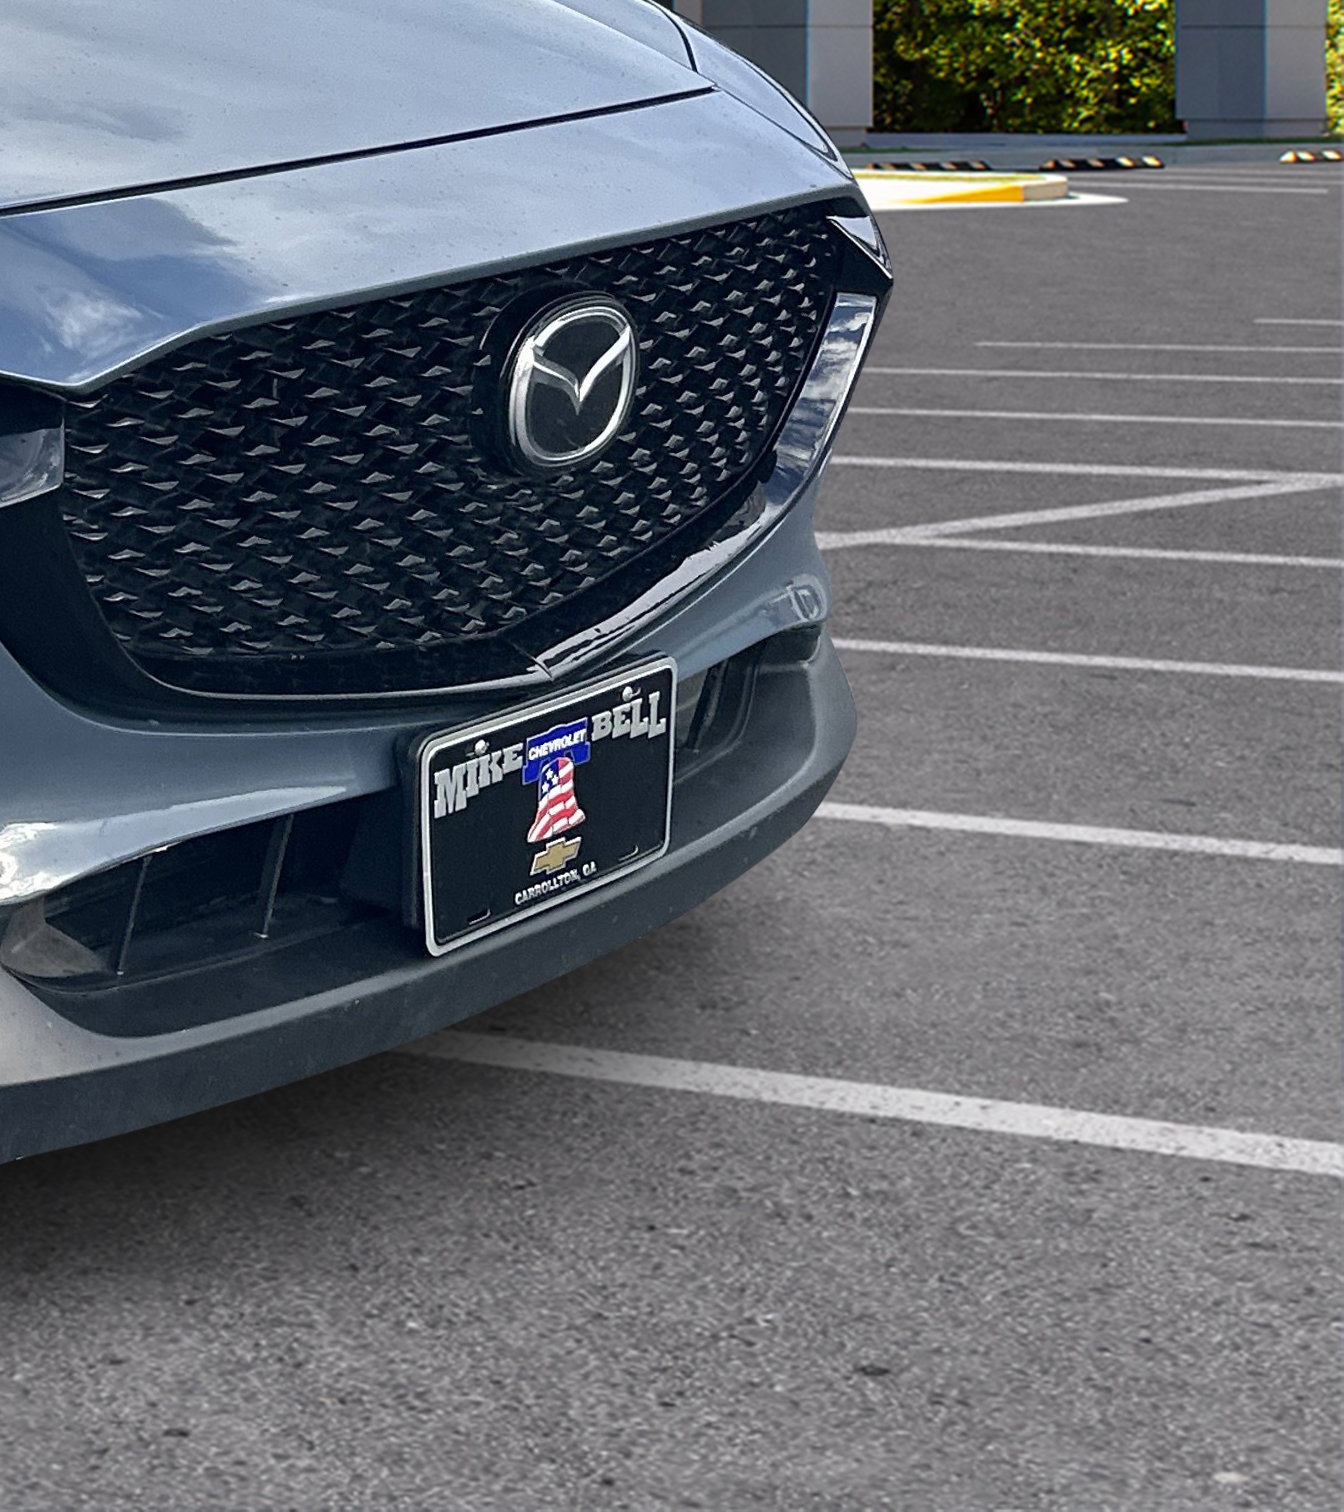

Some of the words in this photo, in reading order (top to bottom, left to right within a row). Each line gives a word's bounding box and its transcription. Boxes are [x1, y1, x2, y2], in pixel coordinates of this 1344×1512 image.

[433, 742, 524, 819] MIKE
[590, 690, 667, 742] BELL
[528, 728, 587, 760] CHEVROLET
